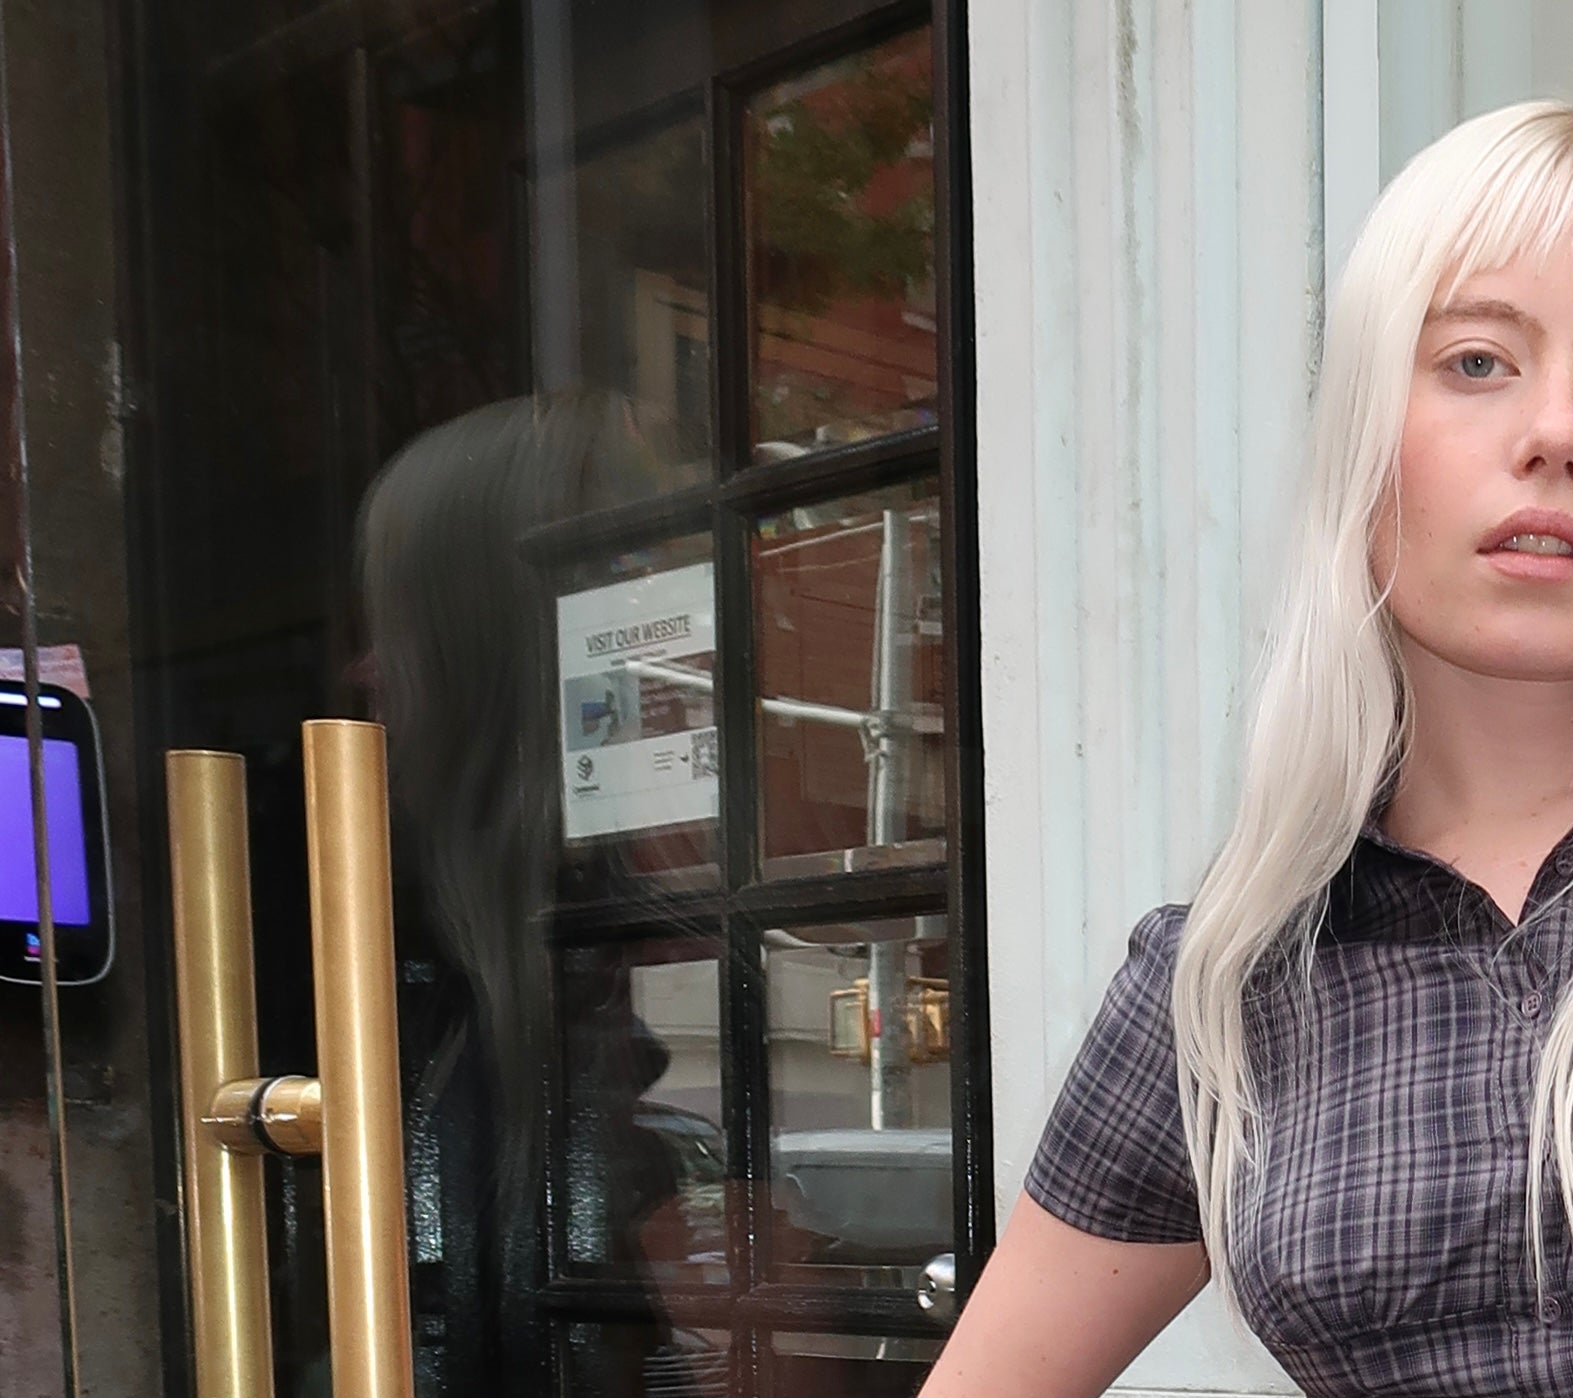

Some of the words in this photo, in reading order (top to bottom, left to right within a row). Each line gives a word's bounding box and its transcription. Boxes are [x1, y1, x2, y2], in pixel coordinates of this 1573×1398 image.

[585, 631, 612, 653] VISIT
[615, 625, 640, 648] OUR
[642, 614, 691, 641] WEBSITE
